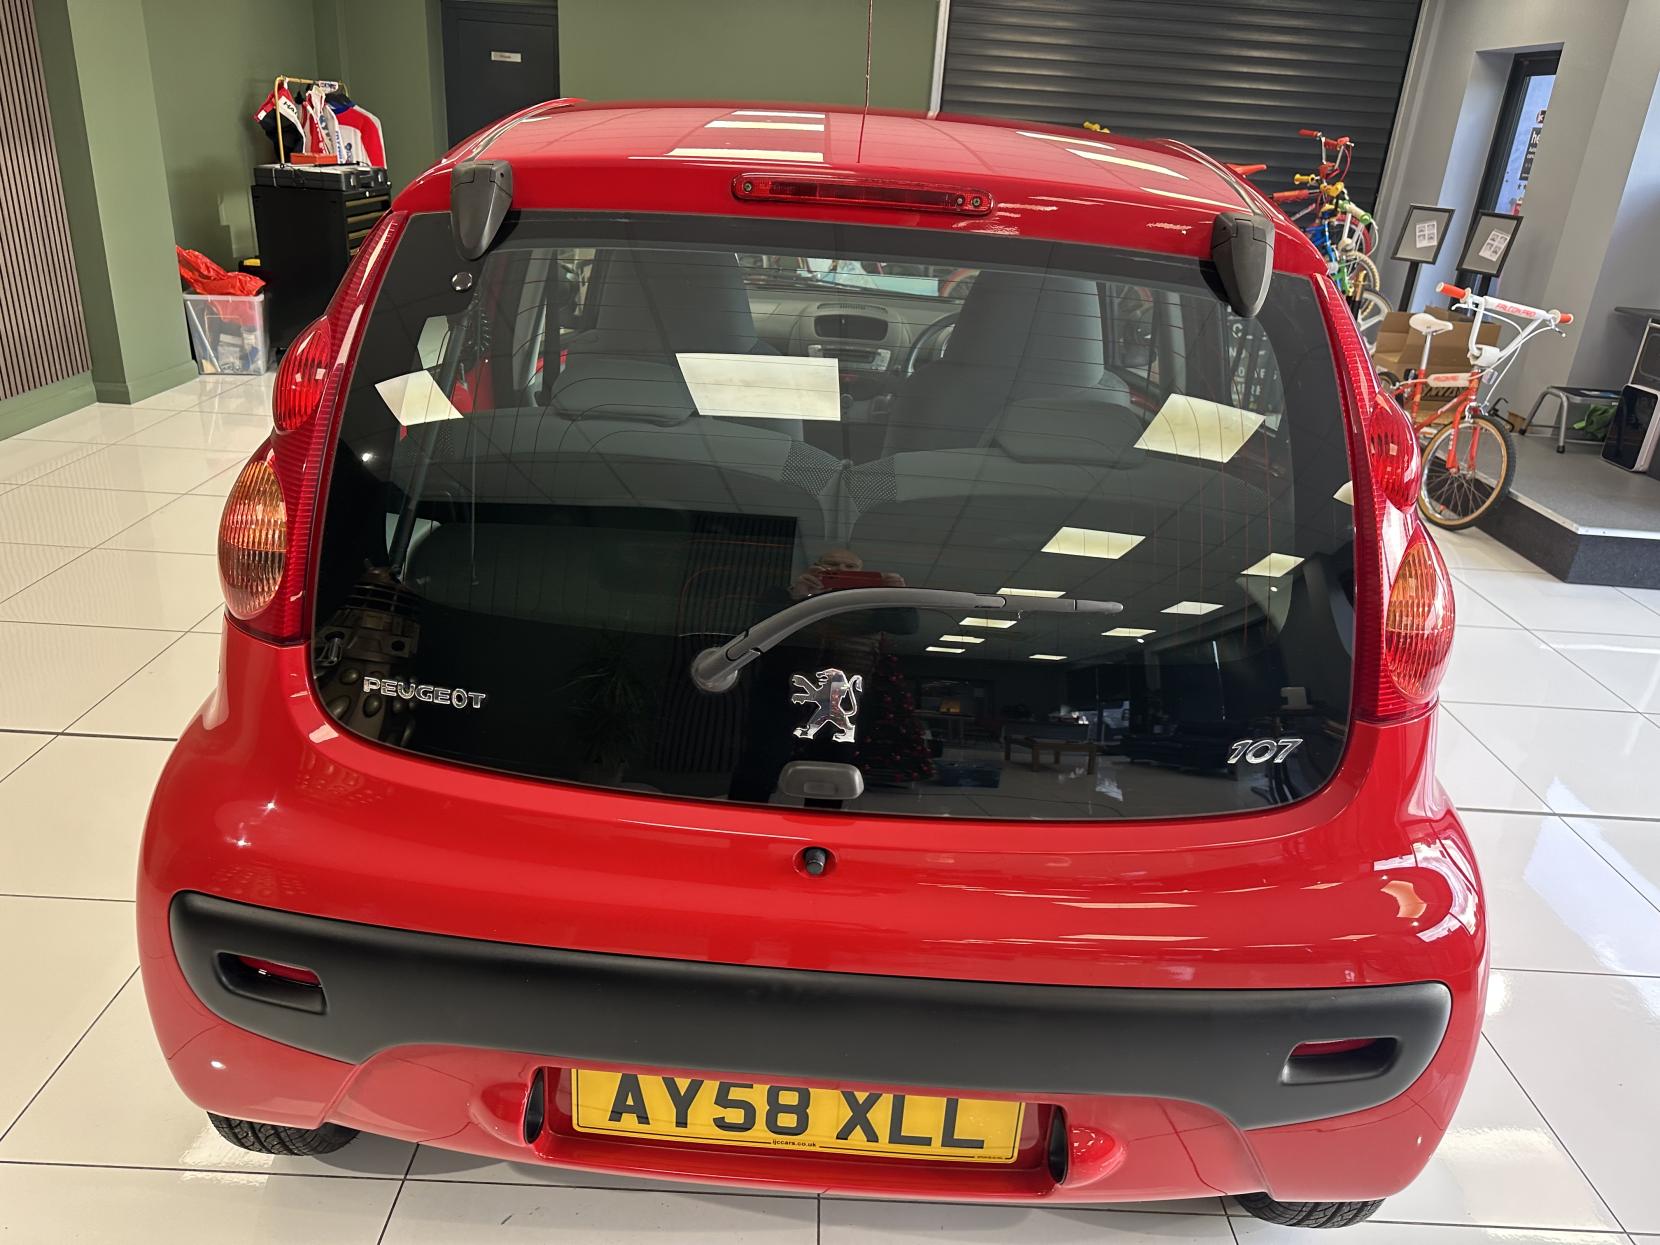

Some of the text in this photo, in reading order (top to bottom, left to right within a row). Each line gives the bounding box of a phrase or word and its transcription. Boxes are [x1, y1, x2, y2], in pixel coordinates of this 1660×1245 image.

[363, 676, 486, 709] PEUGEOT
[1227, 738, 1304, 764] 107
[608, 1073, 985, 1149] AY58 XLL
